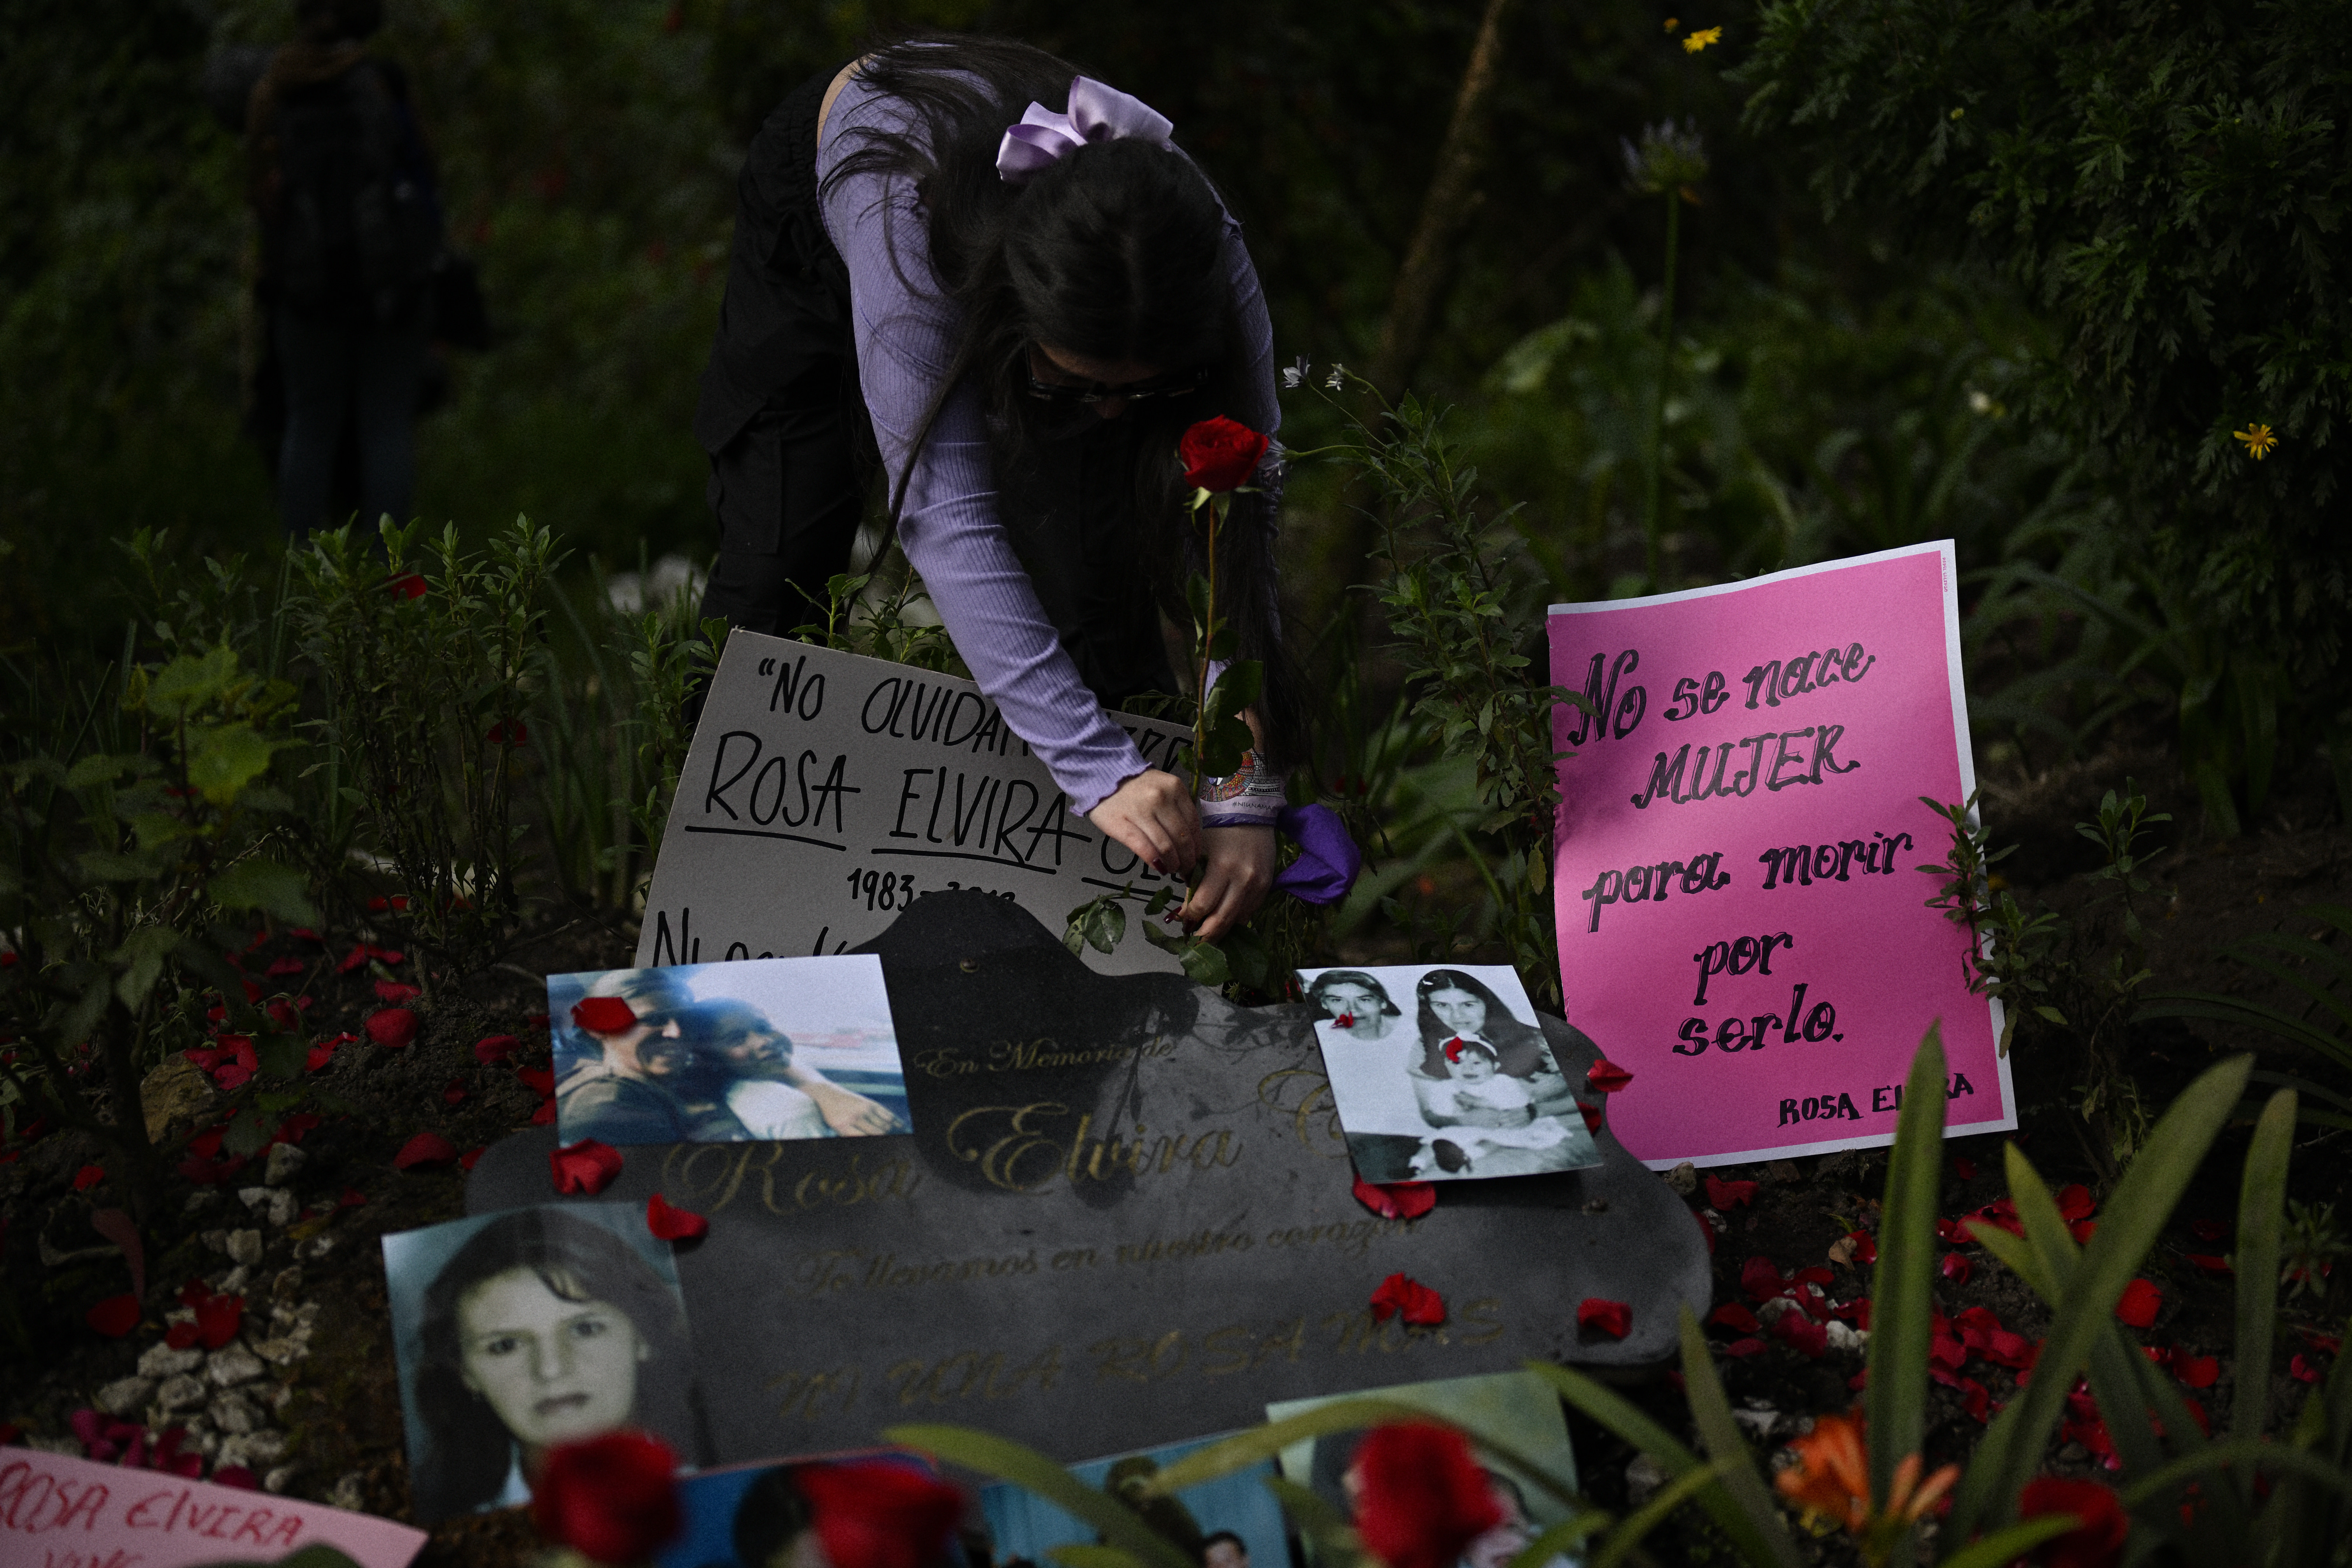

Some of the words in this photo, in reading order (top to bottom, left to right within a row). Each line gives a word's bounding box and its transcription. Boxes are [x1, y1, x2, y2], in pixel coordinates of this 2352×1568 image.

[1567, 649, 1647, 747] No
[1663, 671, 1731, 721] se
[1742, 642, 1876, 710] nace
[705, 730, 861, 833] ROSA
[889, 766, 1092, 866] ELVIRA
[1630, 724, 1861, 809] MUJER
[1582, 852, 1731, 933] para
[1759, 831, 1914, 890] morir
[1693, 931, 1794, 1006] por
[913, 1047, 978, 1078] En
[988, 1038, 1133, 1073] Memoria
[1672, 982, 1844, 1056] serlo.
[1777, 1092, 1864, 1128] ROSA
[660, 1143, 924, 1215] Rosa
[947, 1101, 1243, 1195] Elvira
[1088, 1317, 1307, 1386] ROSA
